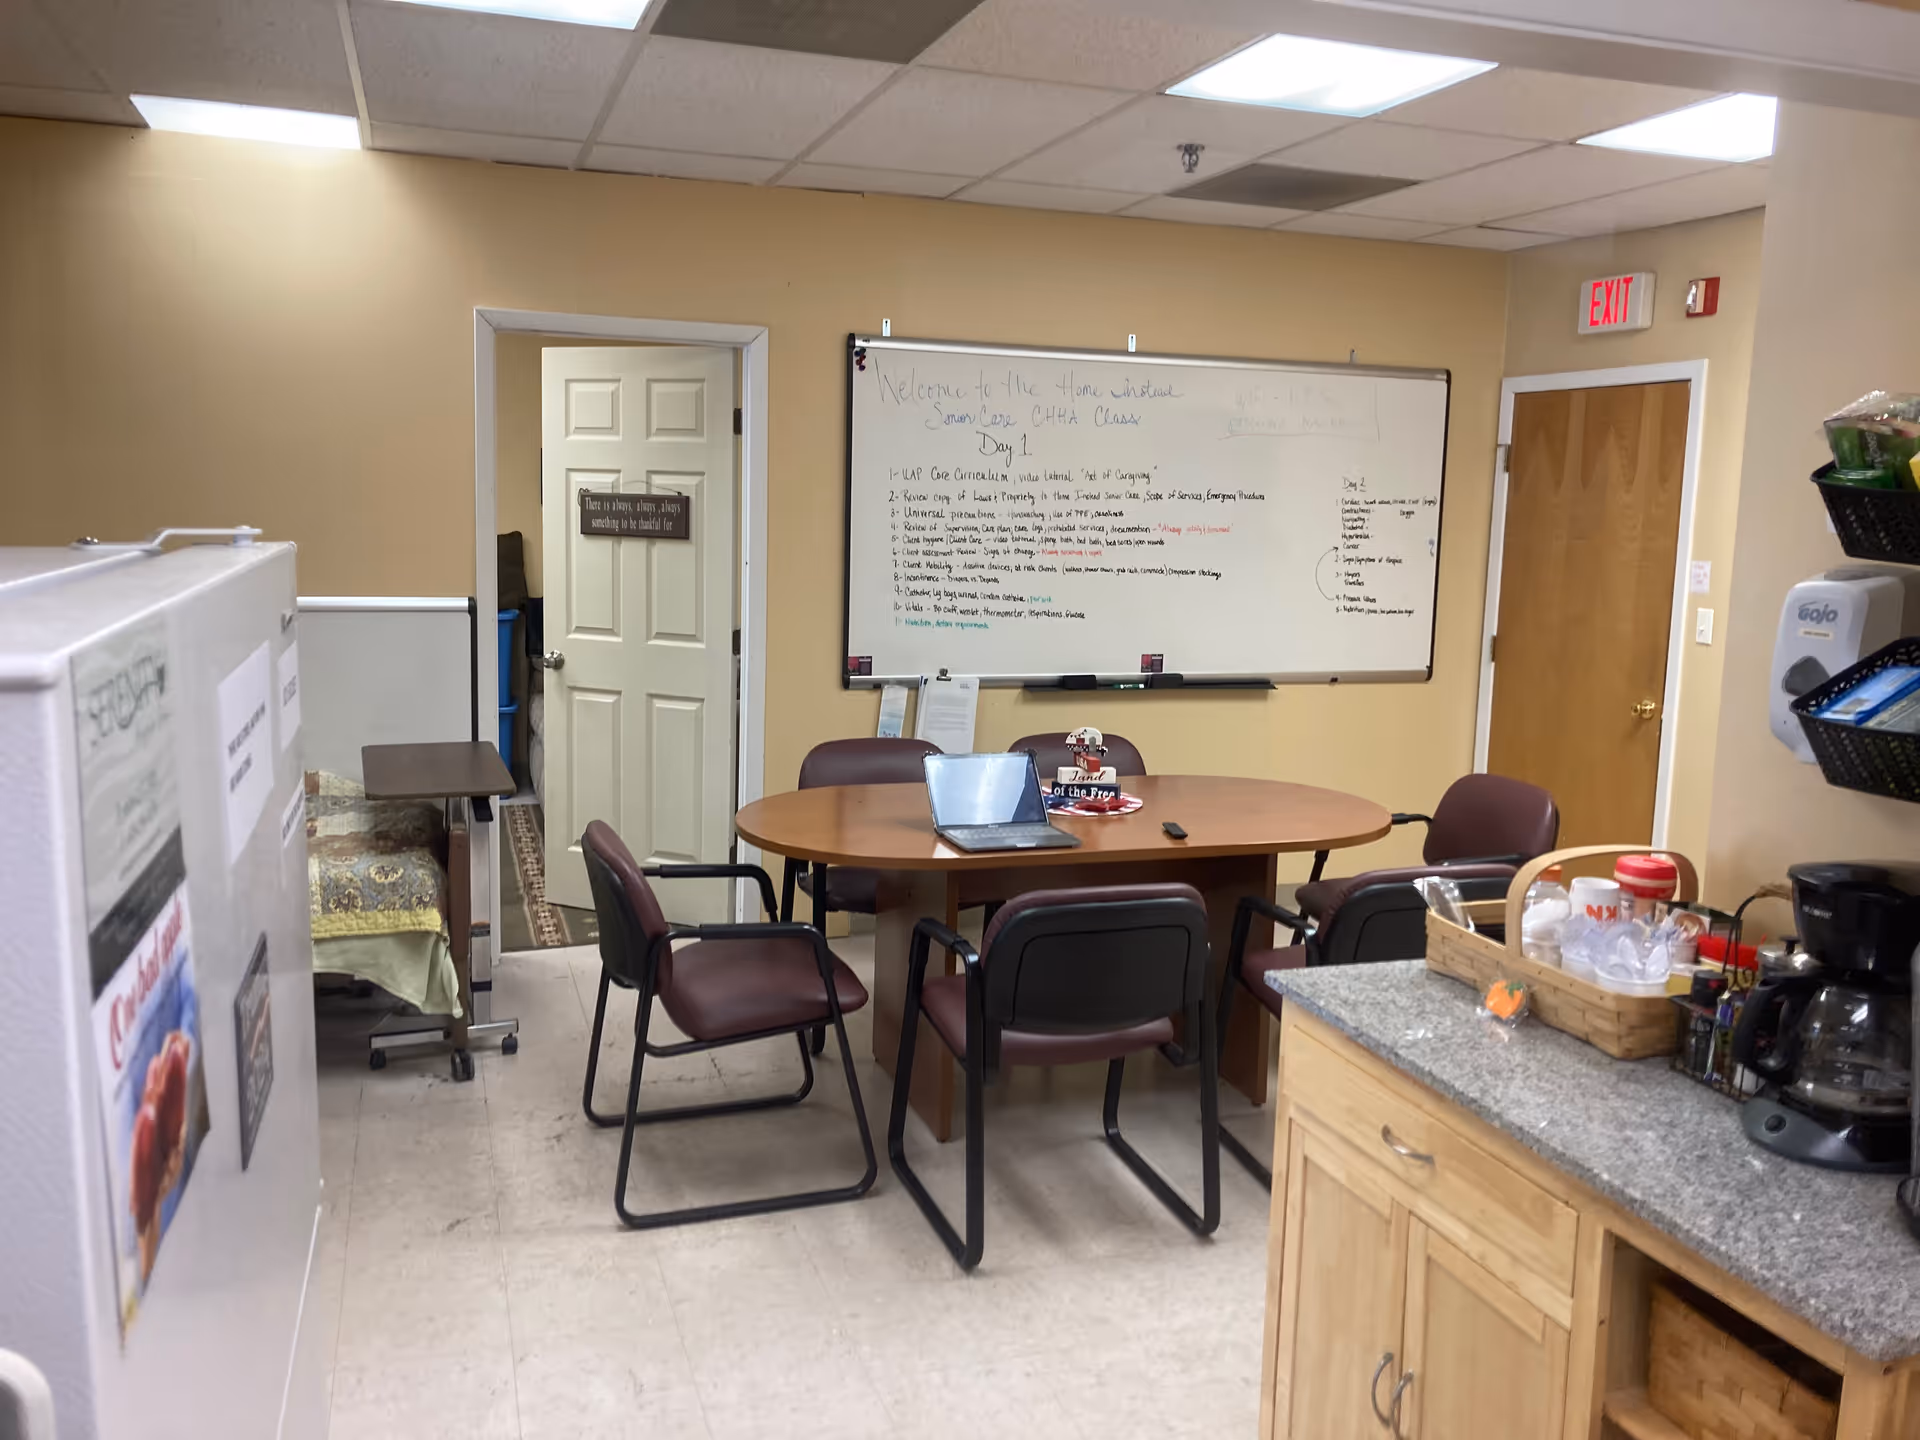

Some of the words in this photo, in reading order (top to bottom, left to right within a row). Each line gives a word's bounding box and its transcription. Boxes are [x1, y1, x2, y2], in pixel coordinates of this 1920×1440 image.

[1588, 276, 1634, 327] EXIT
[874, 356, 967, 406] Welcome
[975, 369, 991, 401] to
[1001, 369, 1039, 398] the
[1056, 368, 1103, 402] Home
[979, 403, 1018, 428] Care
[1031, 404, 1078, 427] CHHA
[1094, 404, 1142, 428] Class
[975, 430, 1013, 467] Day
[1019, 432, 1033, 457] 1
[930, 465, 950, 481] Core
[1102, 469, 1112, 480] of
[903, 489, 929, 501] Review
[933, 493, 952, 505] copy
[957, 490, 967, 501] of
[585, 496, 601, 512] There
[603, 499, 610, 511] is
[661, 499, 681, 517] always
[904, 507, 946, 519] Universal
[950, 508, 996, 521] precautions
[591, 515, 620, 532] something
[621, 517, 628, 530] to
[629, 516, 637, 530] be
[638, 516, 661, 531] thankful
[663, 518, 673, 531] for
[904, 522, 927, 532] Review
[1076, 756, 1088, 771] USA
[1069, 770, 1107, 783] Land
[1053, 784, 1066, 797] of
[1068, 785, 1087, 799] the
[1090, 787, 1115, 801] Free
